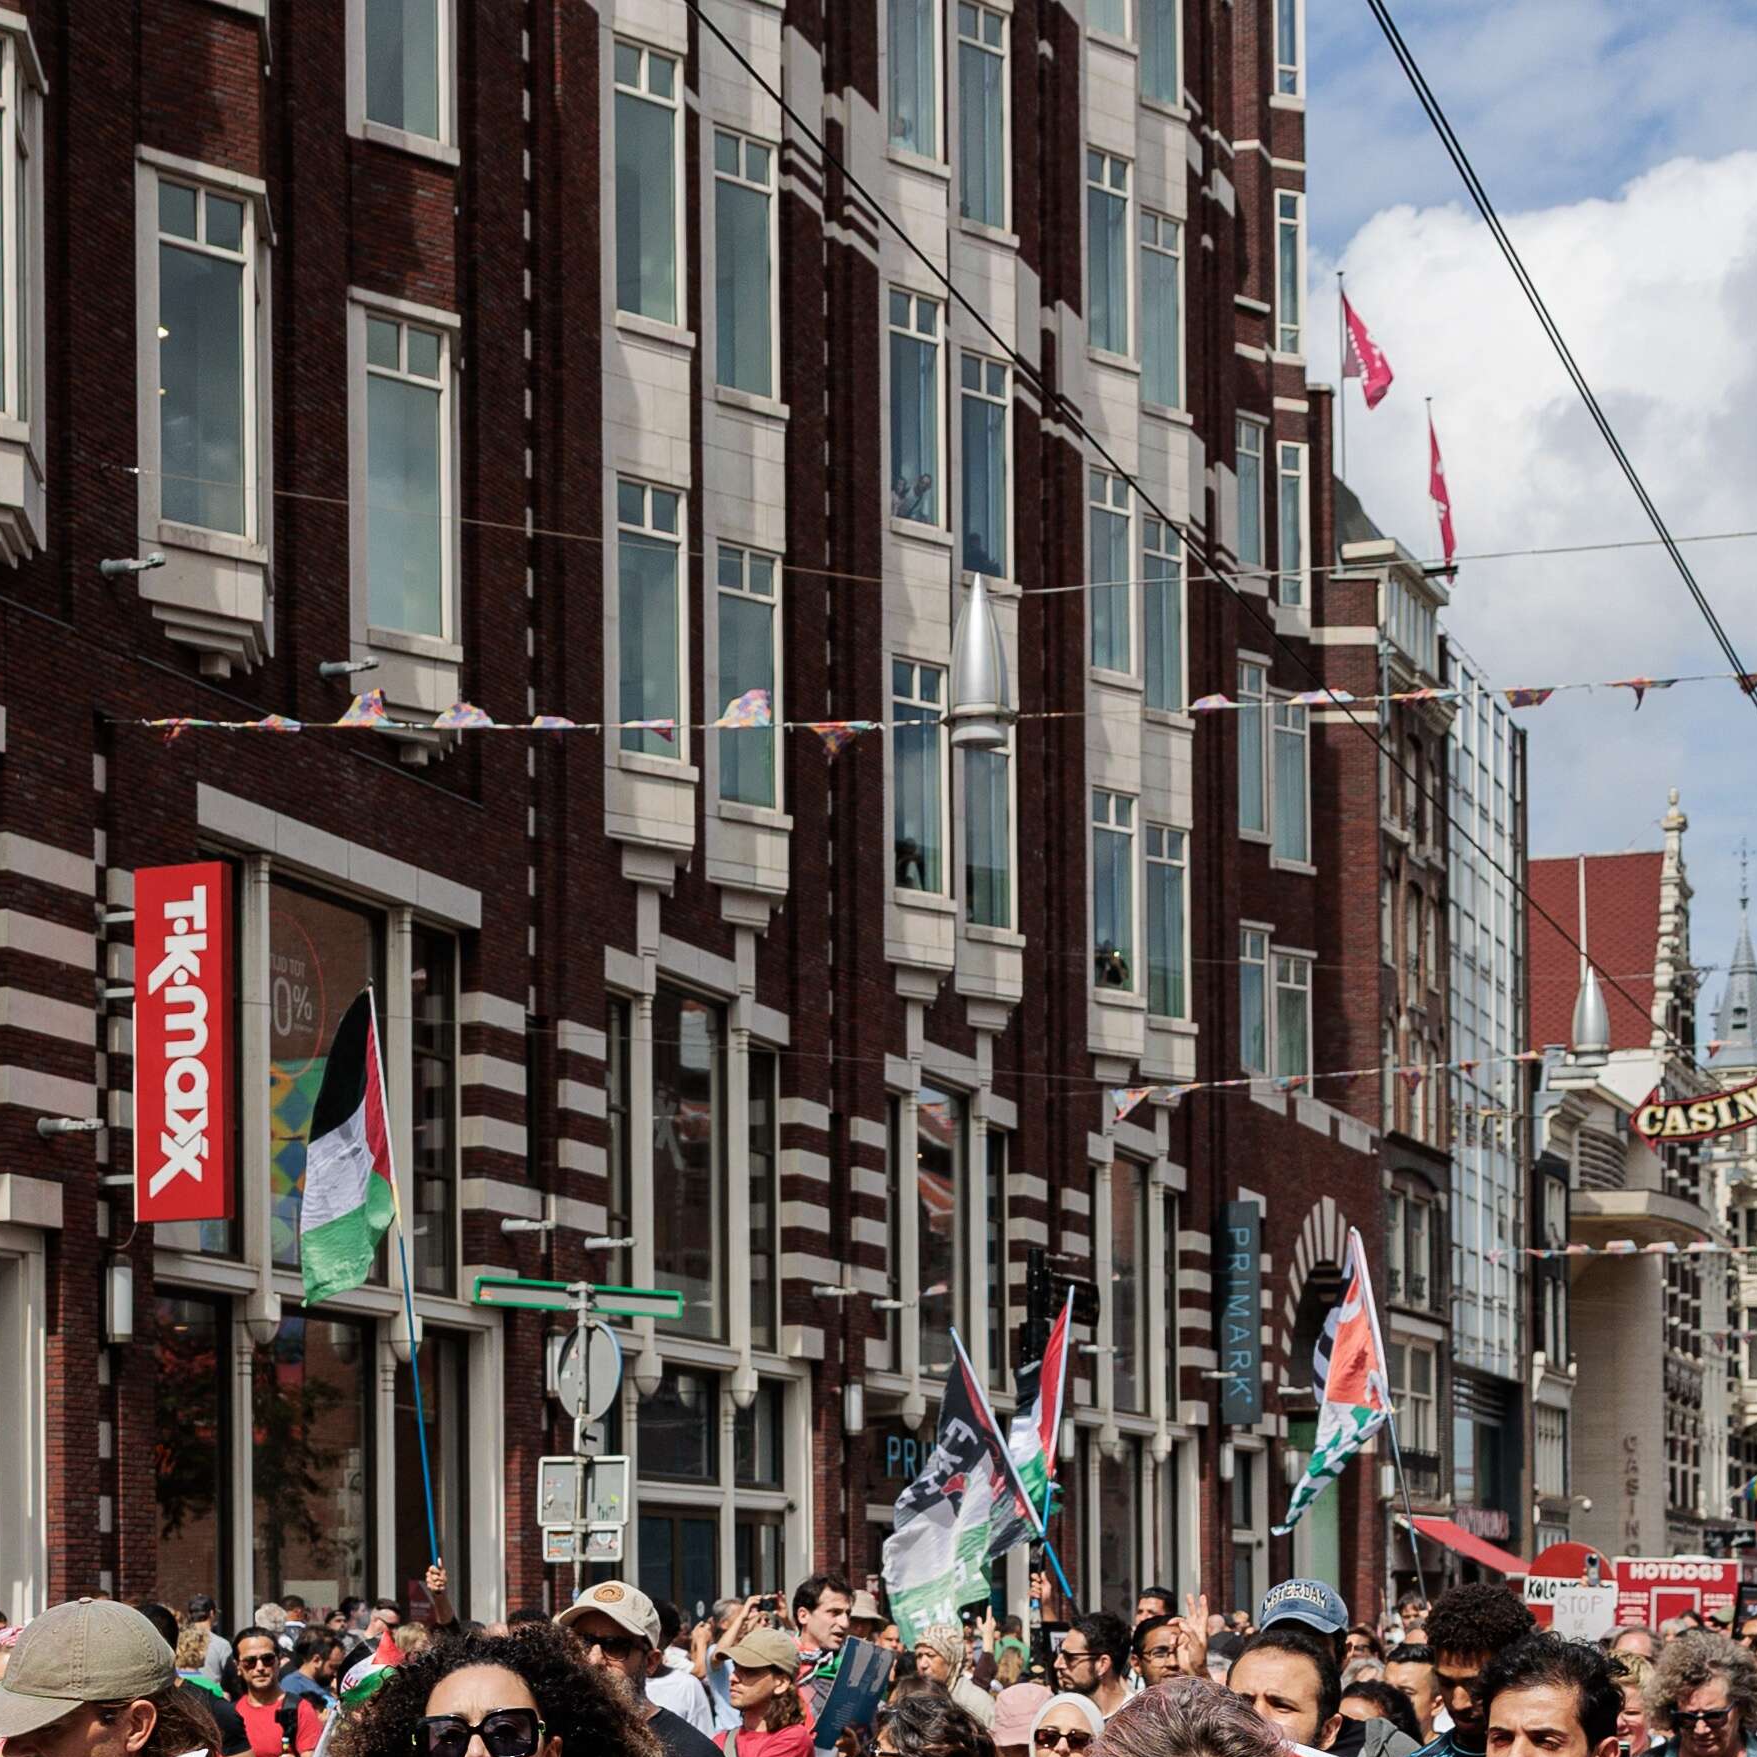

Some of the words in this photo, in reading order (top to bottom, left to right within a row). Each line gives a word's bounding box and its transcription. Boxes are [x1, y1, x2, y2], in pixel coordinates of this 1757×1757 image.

[1228, 1227, 1252, 1397] PRIMARK
[1629, 1563, 1724, 1581] HOTDOGS
[1557, 1595, 1604, 1616] STOP
